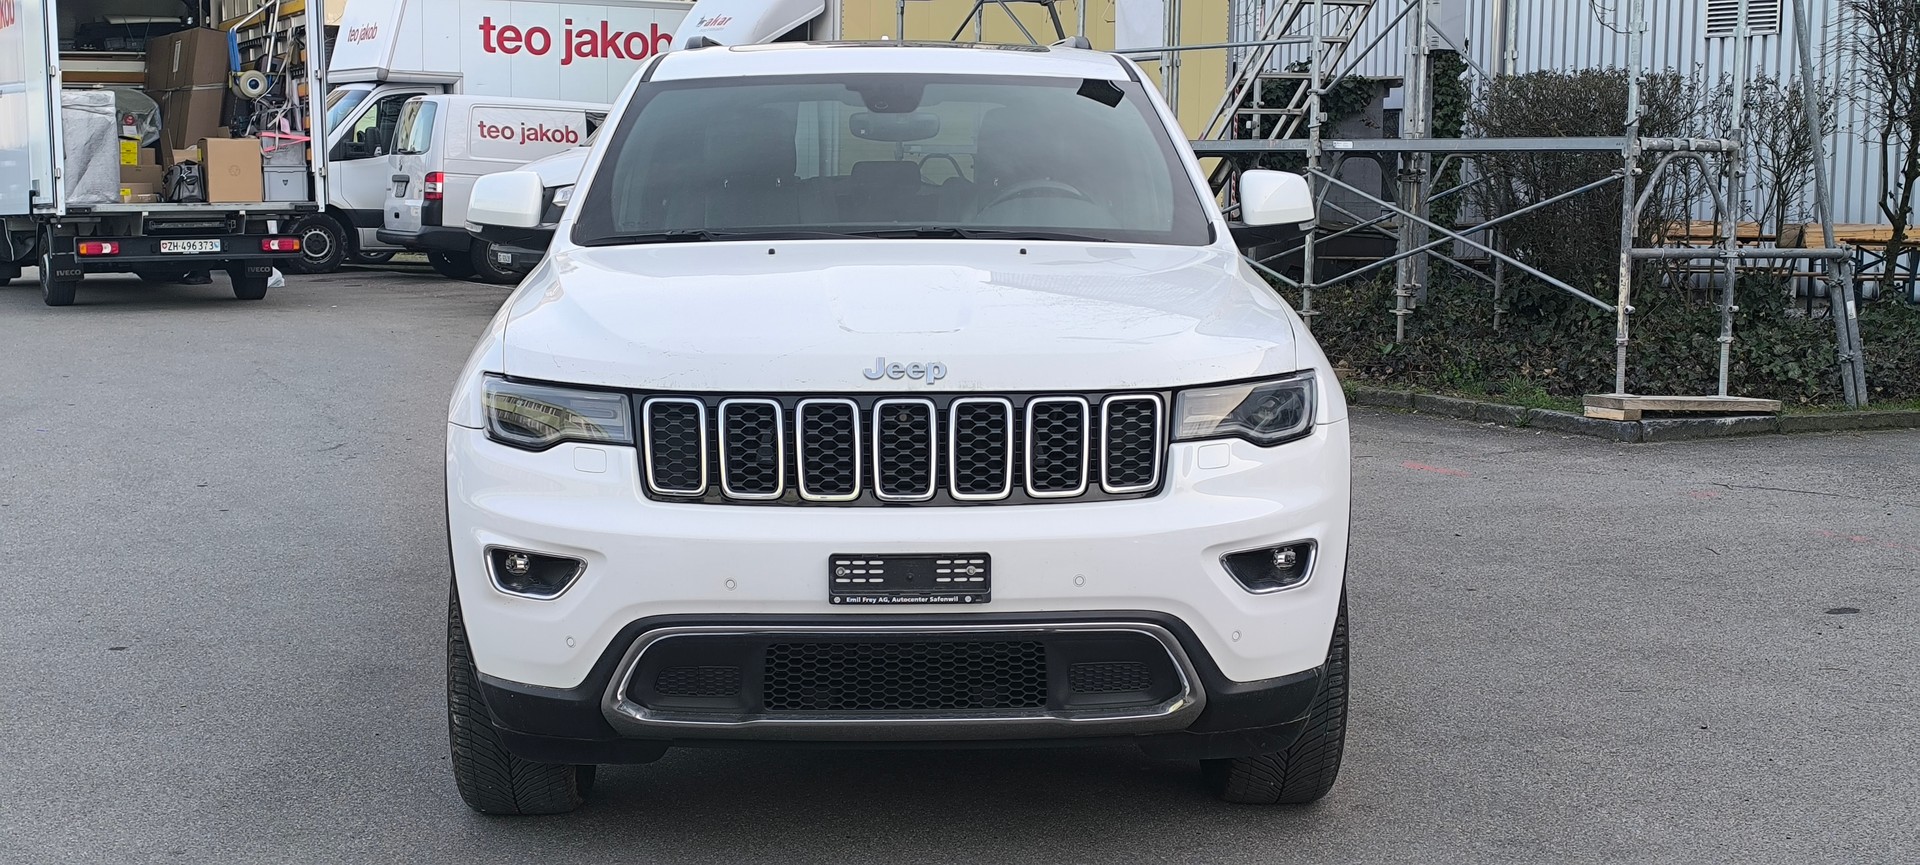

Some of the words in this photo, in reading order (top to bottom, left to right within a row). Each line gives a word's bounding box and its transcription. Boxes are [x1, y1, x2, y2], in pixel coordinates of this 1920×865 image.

[347, 25, 360, 43] teo
[357, 22, 378, 45] jakob
[479, 16, 551, 56] teo
[478, 121, 515, 140] teo
[520, 122, 579, 145] jakob
[863, 356, 947, 385] Jeep
[862, 596, 877, 604] Frey
[878, 596, 890, 604] AG,
